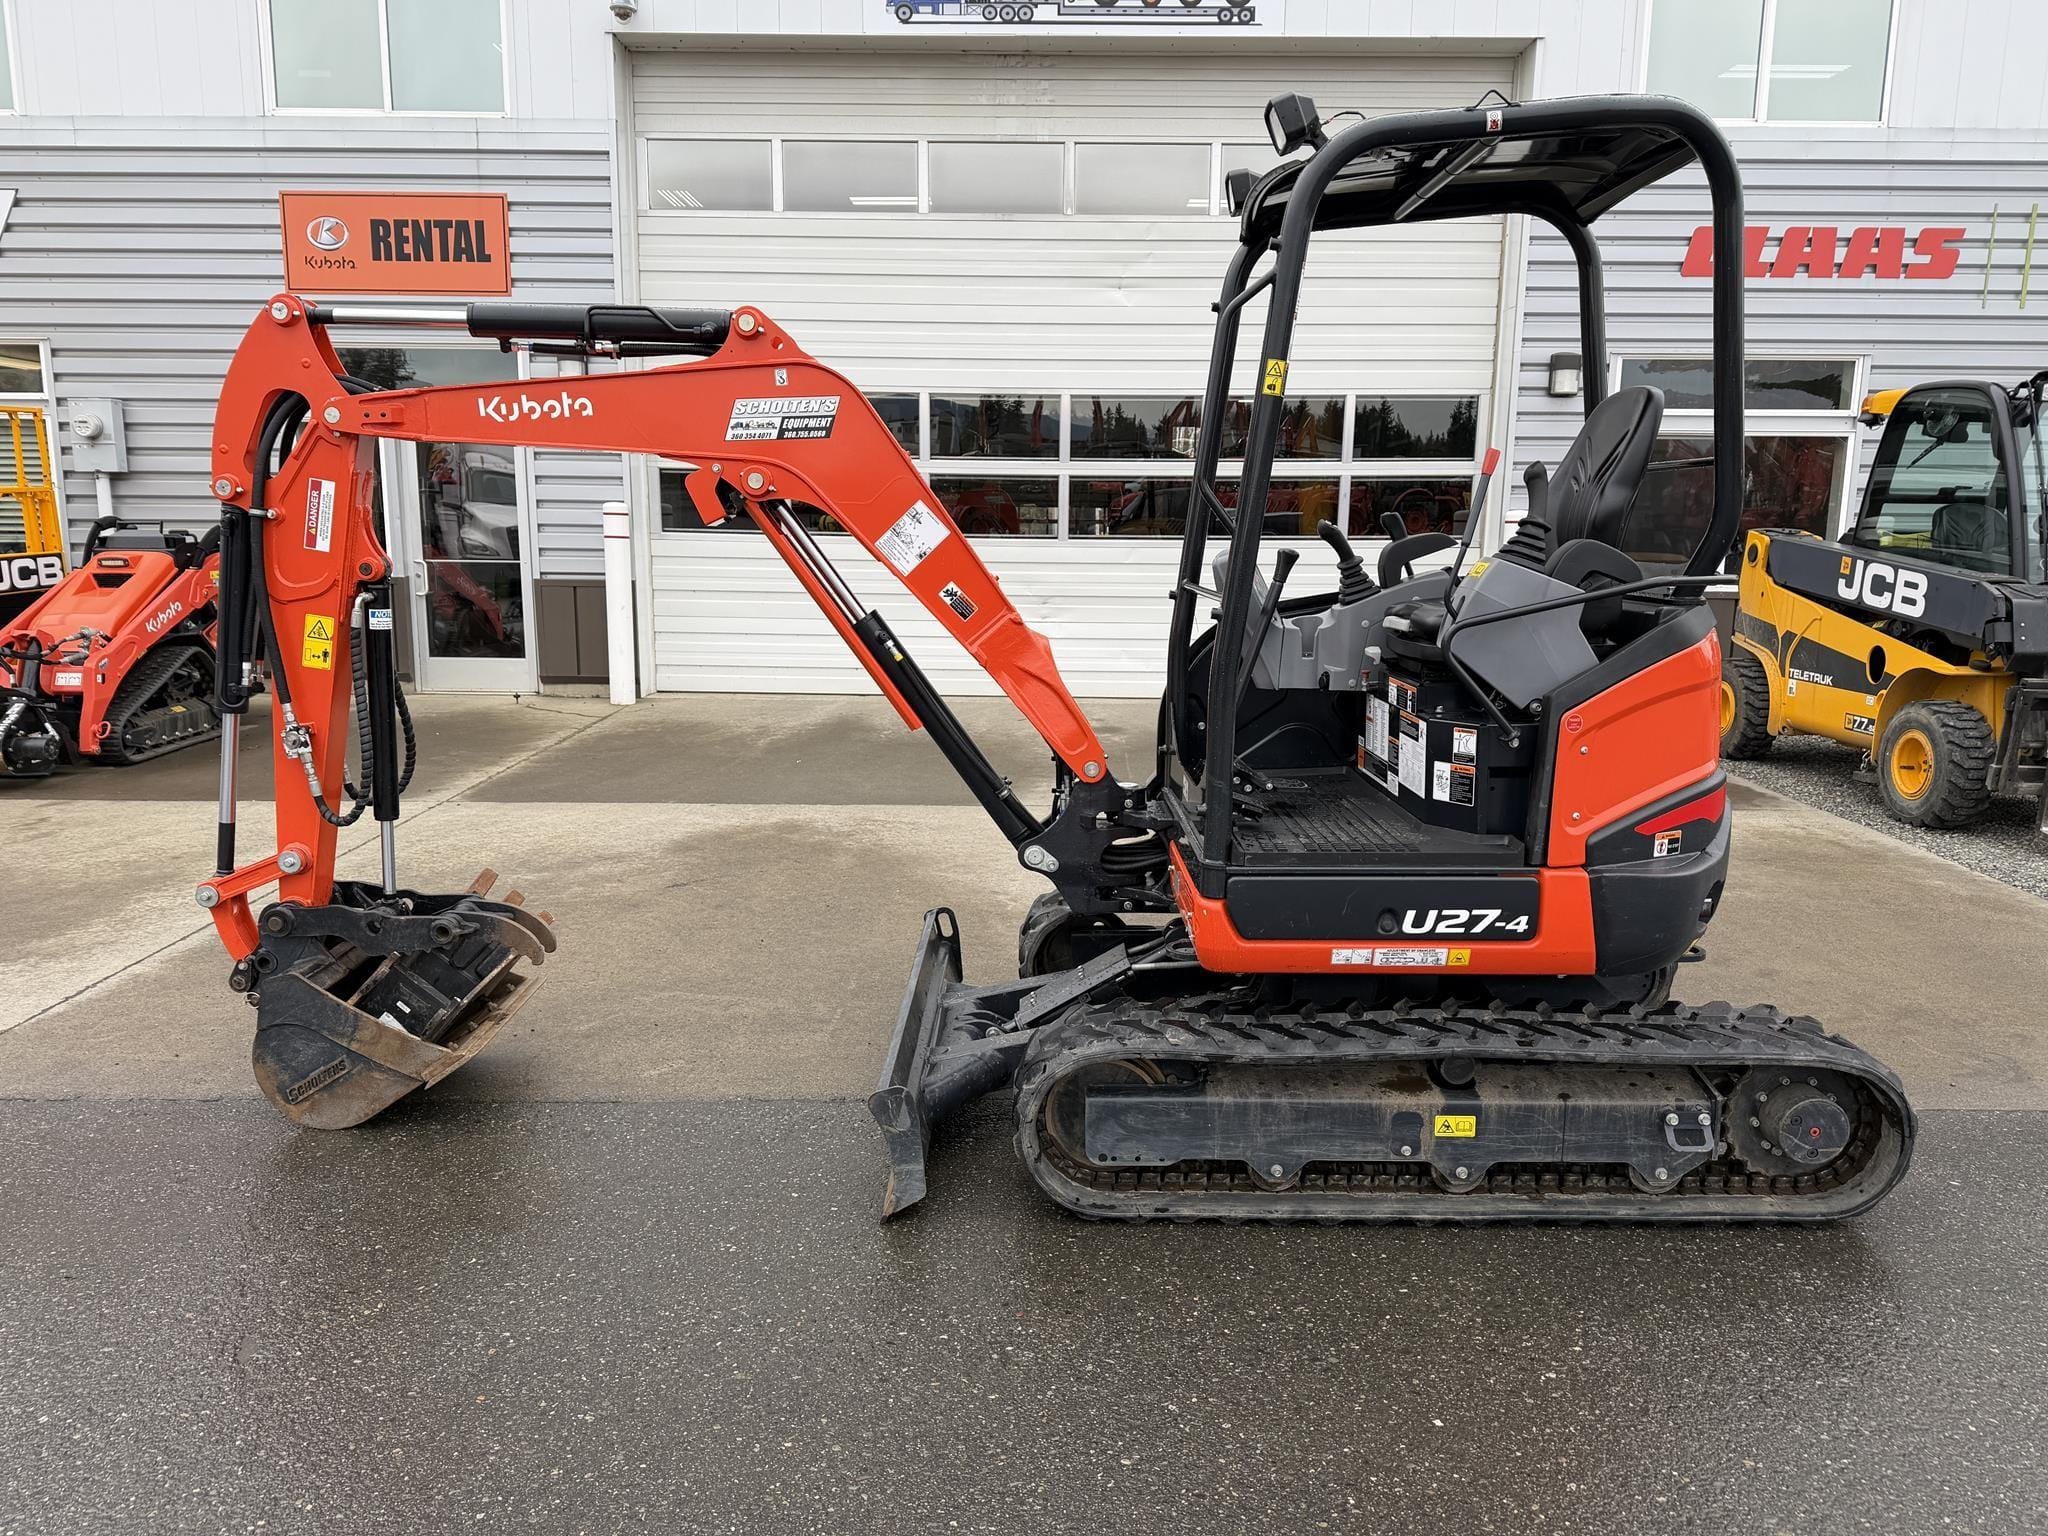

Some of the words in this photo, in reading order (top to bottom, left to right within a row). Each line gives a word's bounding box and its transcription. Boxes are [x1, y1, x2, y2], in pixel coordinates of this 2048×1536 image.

[370, 218, 492, 262] RENTAL
[1680, 226, 1966, 279] CLAAS
[305, 255, 356, 270] Kubota
[478, 391, 594, 422] Kubota
[734, 398, 837, 415] SCHOLTEN'S
[782, 417, 833, 430] EQUIPMENT
[308, 490, 319, 527] DANGER
[1838, 559, 1928, 618] JCB
[145, 599, 182, 634] Kubota
[1788, 668, 1833, 686] TELETRUK
[1401, 908, 1529, 934] U27-4
[288, 1059, 347, 1102] SCHOLTENS
